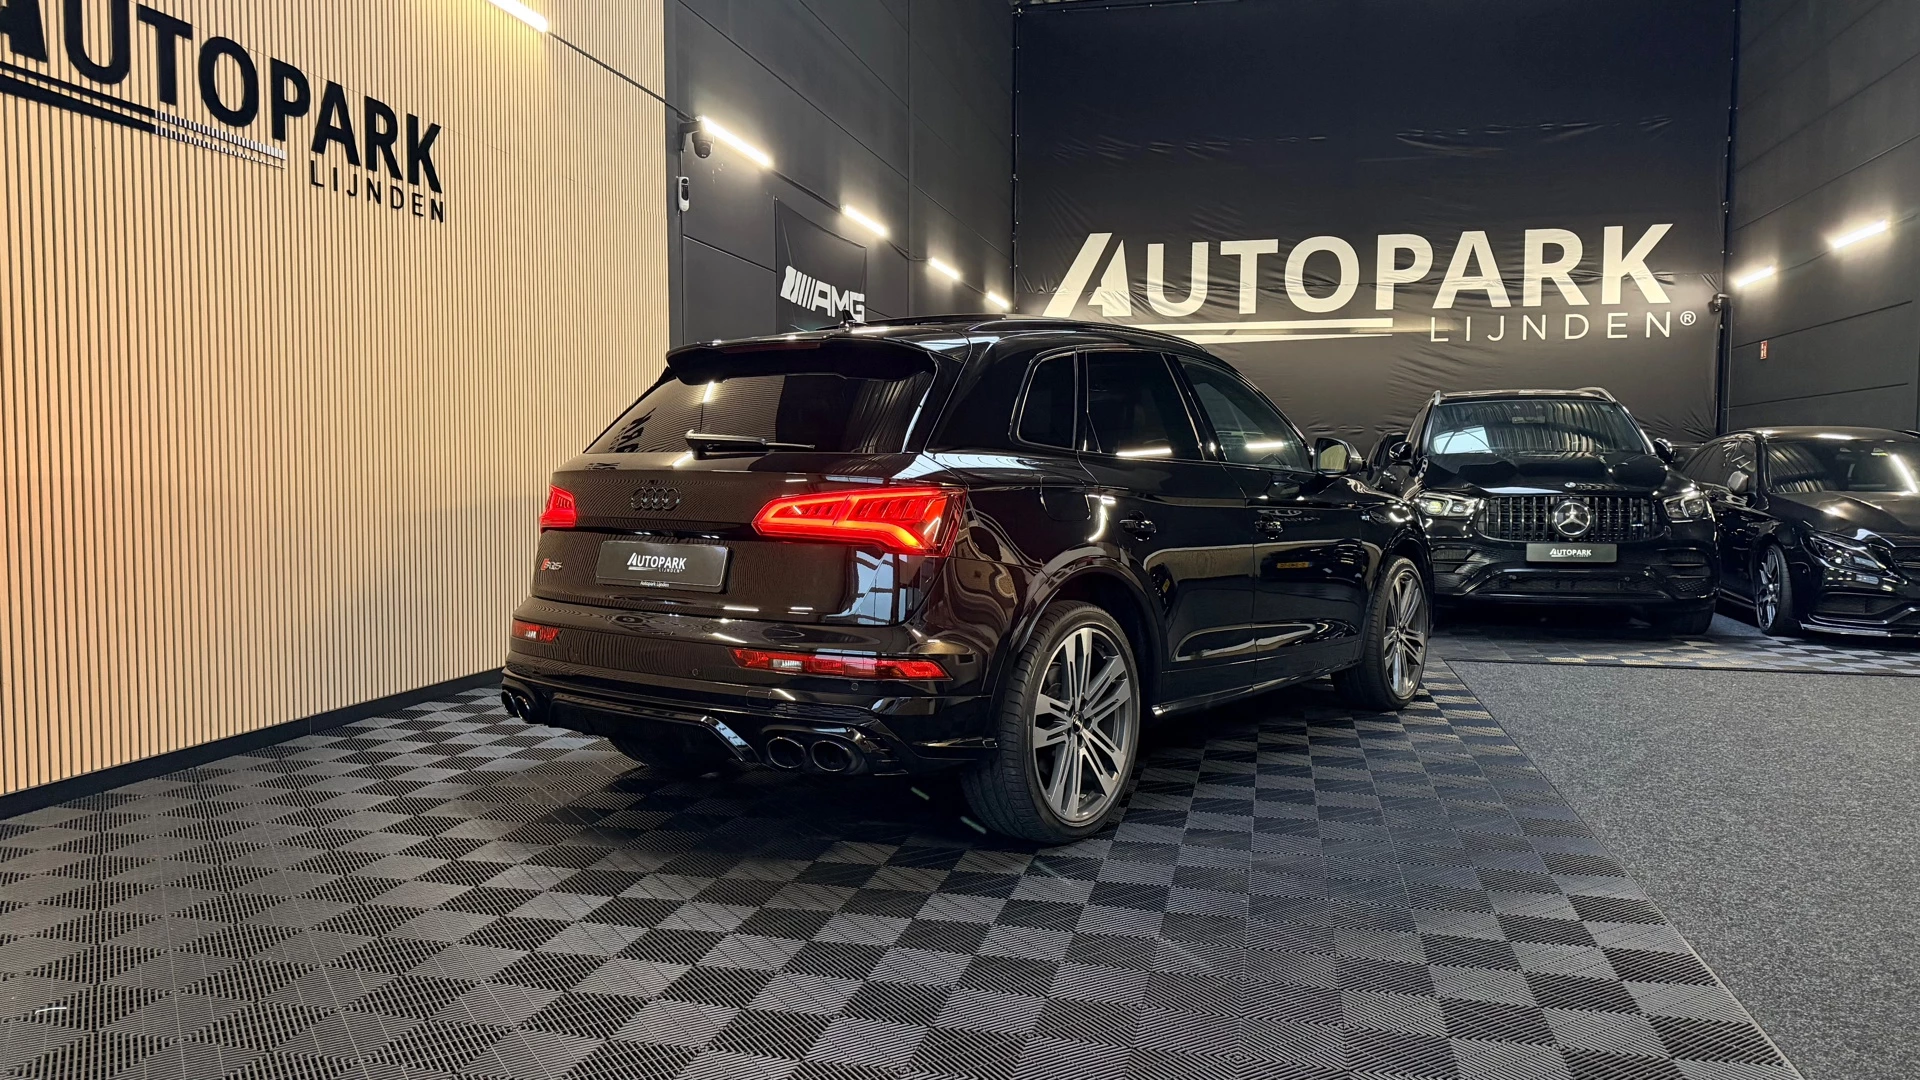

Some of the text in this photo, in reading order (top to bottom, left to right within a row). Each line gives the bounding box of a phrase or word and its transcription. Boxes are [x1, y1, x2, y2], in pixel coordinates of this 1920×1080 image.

[311, 160, 444, 223] LIJNDEN
[1042, 223, 1674, 318] AUTOPARK
[810, 280, 865, 323] AMG
[627, 552, 688, 570] AUTOPARK
[1549, 548, 1592, 556] AUTOPARK
